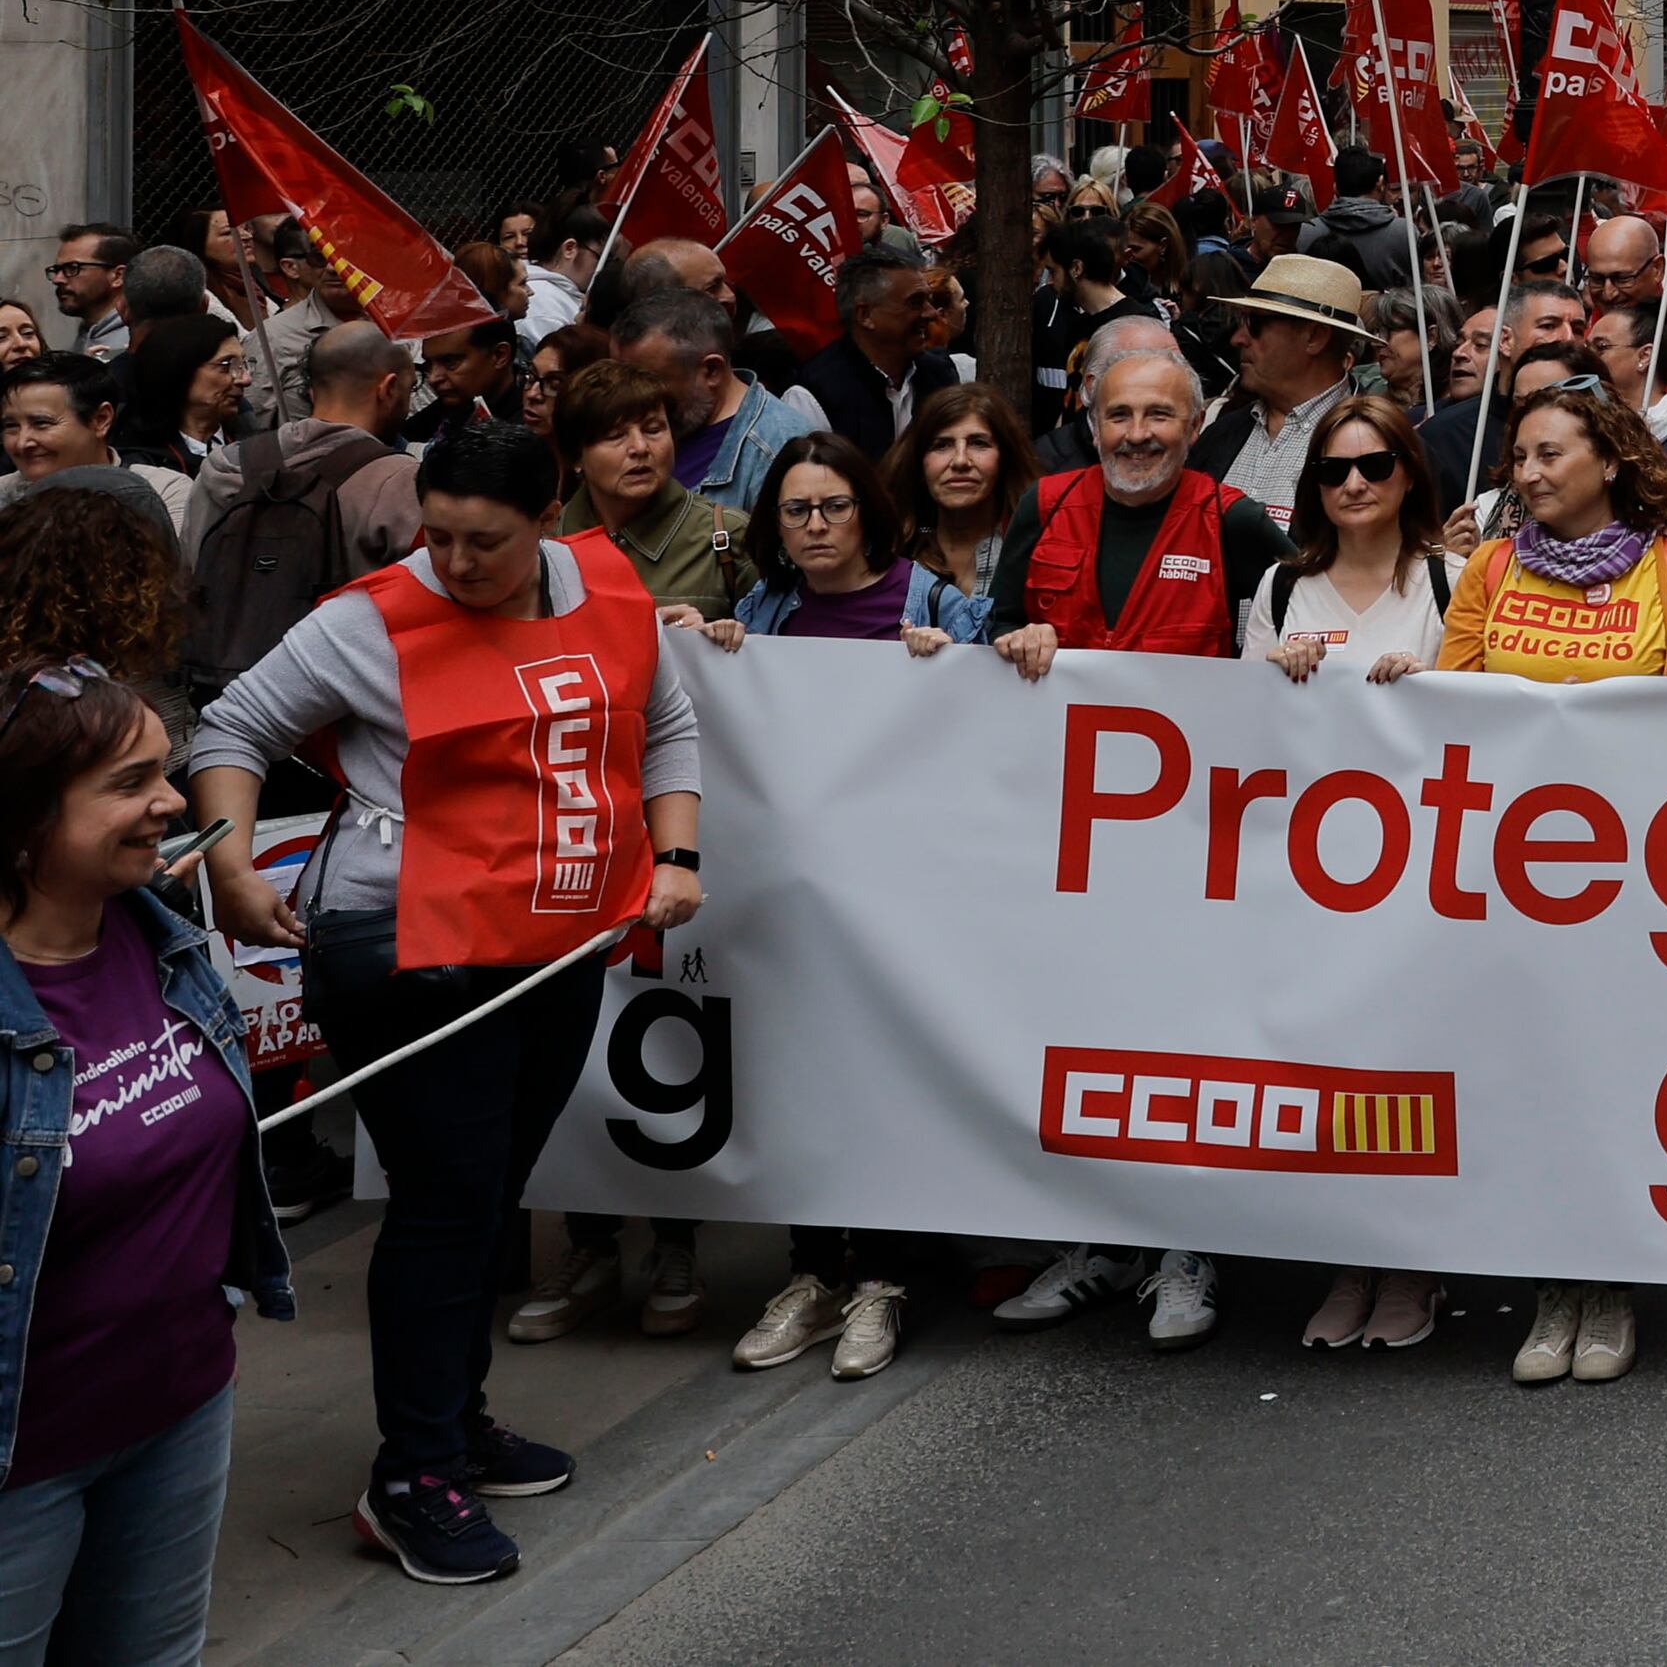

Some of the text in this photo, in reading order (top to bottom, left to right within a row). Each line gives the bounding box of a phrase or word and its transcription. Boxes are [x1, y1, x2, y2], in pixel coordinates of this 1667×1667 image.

[657, 158, 723, 231] valencià
[752, 211, 839, 293] país vale
[1158, 568, 1198, 583] hàbitat
[1162, 556, 1198, 570] CCOO
[1499, 597, 1599, 631] CCOO
[1487, 628, 1634, 662] educació
[538, 671, 598, 858] CCOO
[66, 1018, 204, 1137] eminista
[72, 1040, 147, 1086] indicalista
[140, 1096, 184, 1127] CCOO
[1063, 1069, 1320, 1153] CCOO
